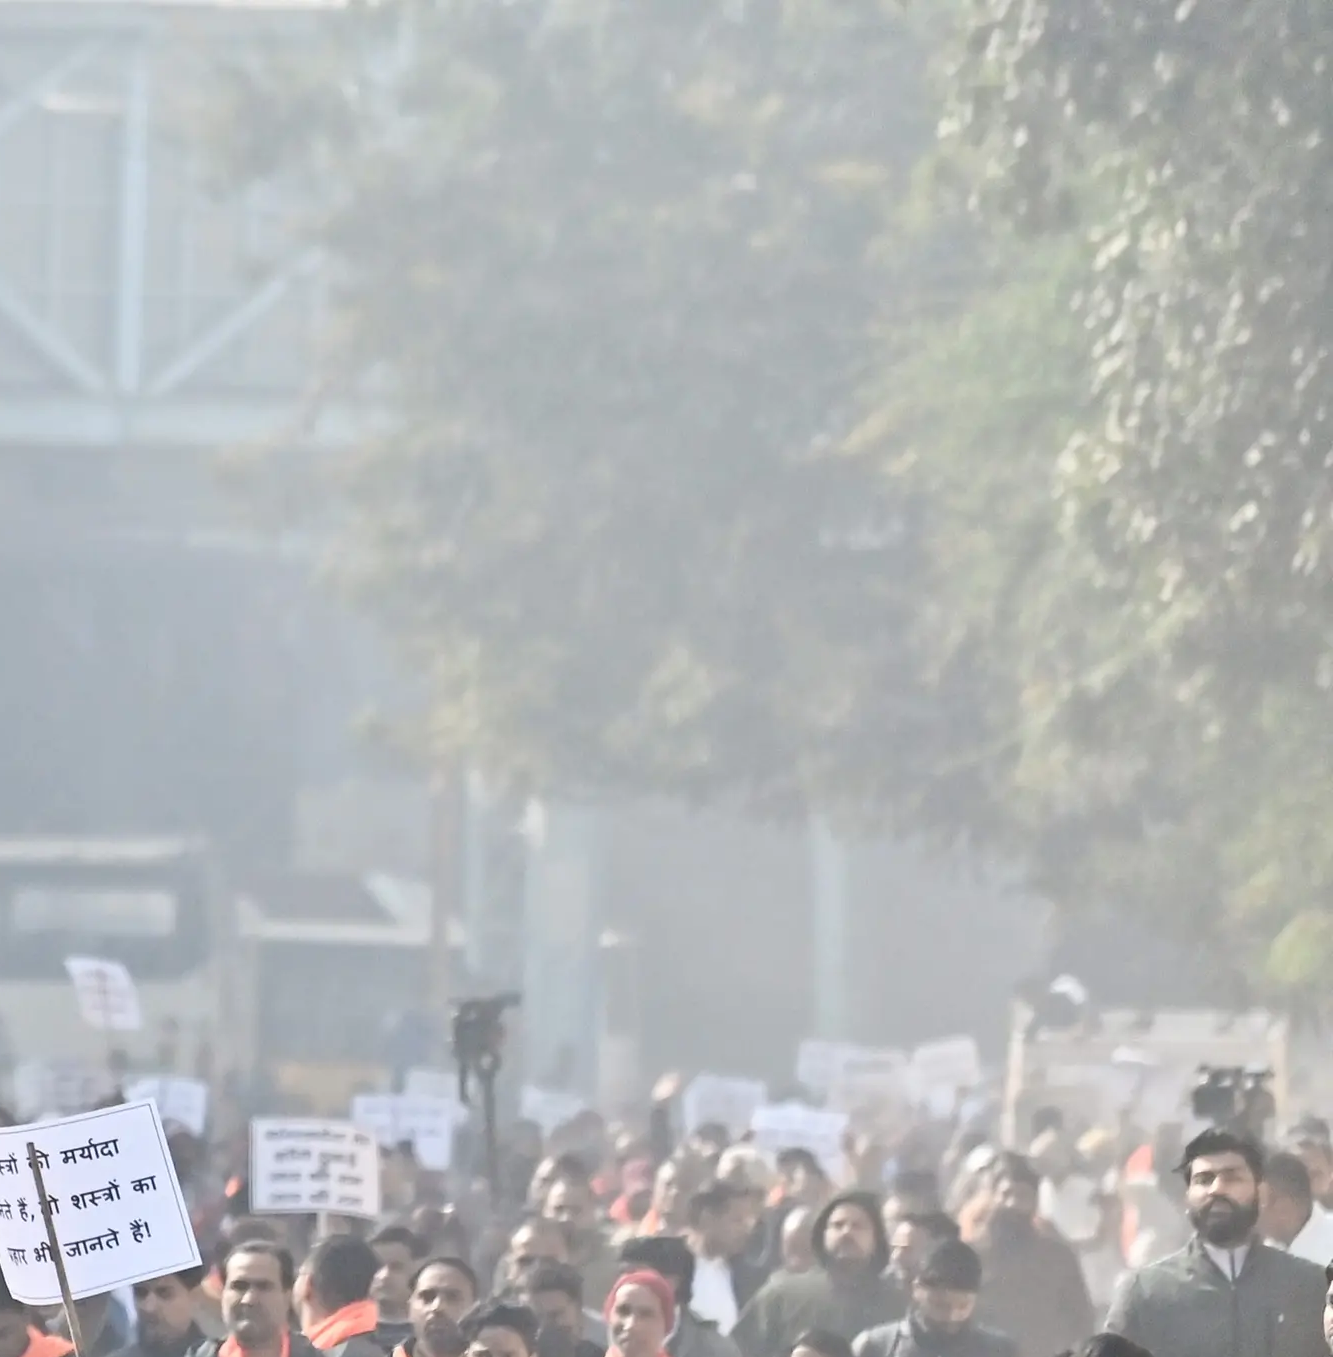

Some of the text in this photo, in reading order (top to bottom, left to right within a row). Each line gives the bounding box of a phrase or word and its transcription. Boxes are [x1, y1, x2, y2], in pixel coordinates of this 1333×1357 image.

[60, 1138, 120, 1165] मर्यादा
[71, 1179, 122, 1210] शस्त्रों
[131, 1175, 157, 1195] का
[63, 1228, 120, 1258] जानते
[129, 1218, 152, 1244] हैं!
